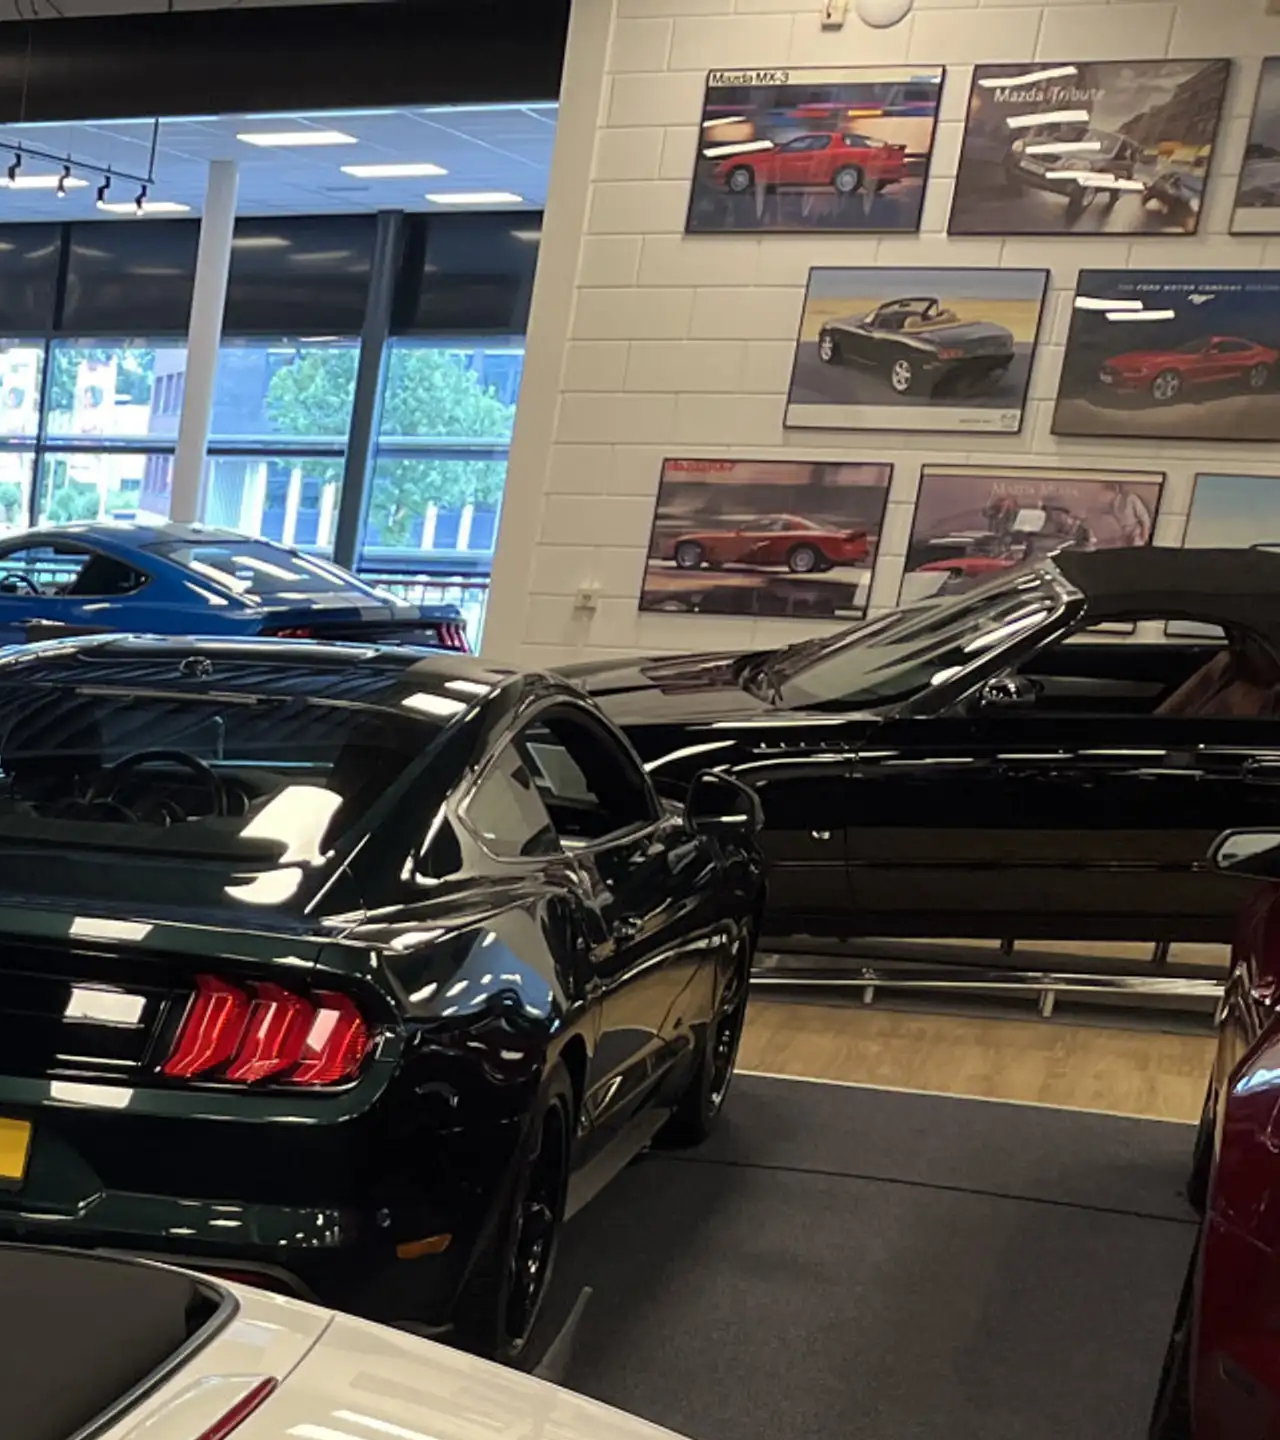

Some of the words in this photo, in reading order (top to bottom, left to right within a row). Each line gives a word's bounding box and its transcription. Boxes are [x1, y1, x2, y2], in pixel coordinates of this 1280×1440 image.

[711, 71, 753, 84] Mazda
[755, 71, 790, 84] MX-3
[993, 86, 1044, 103] Mazda
[1050, 86, 1106, 104] Tribute
